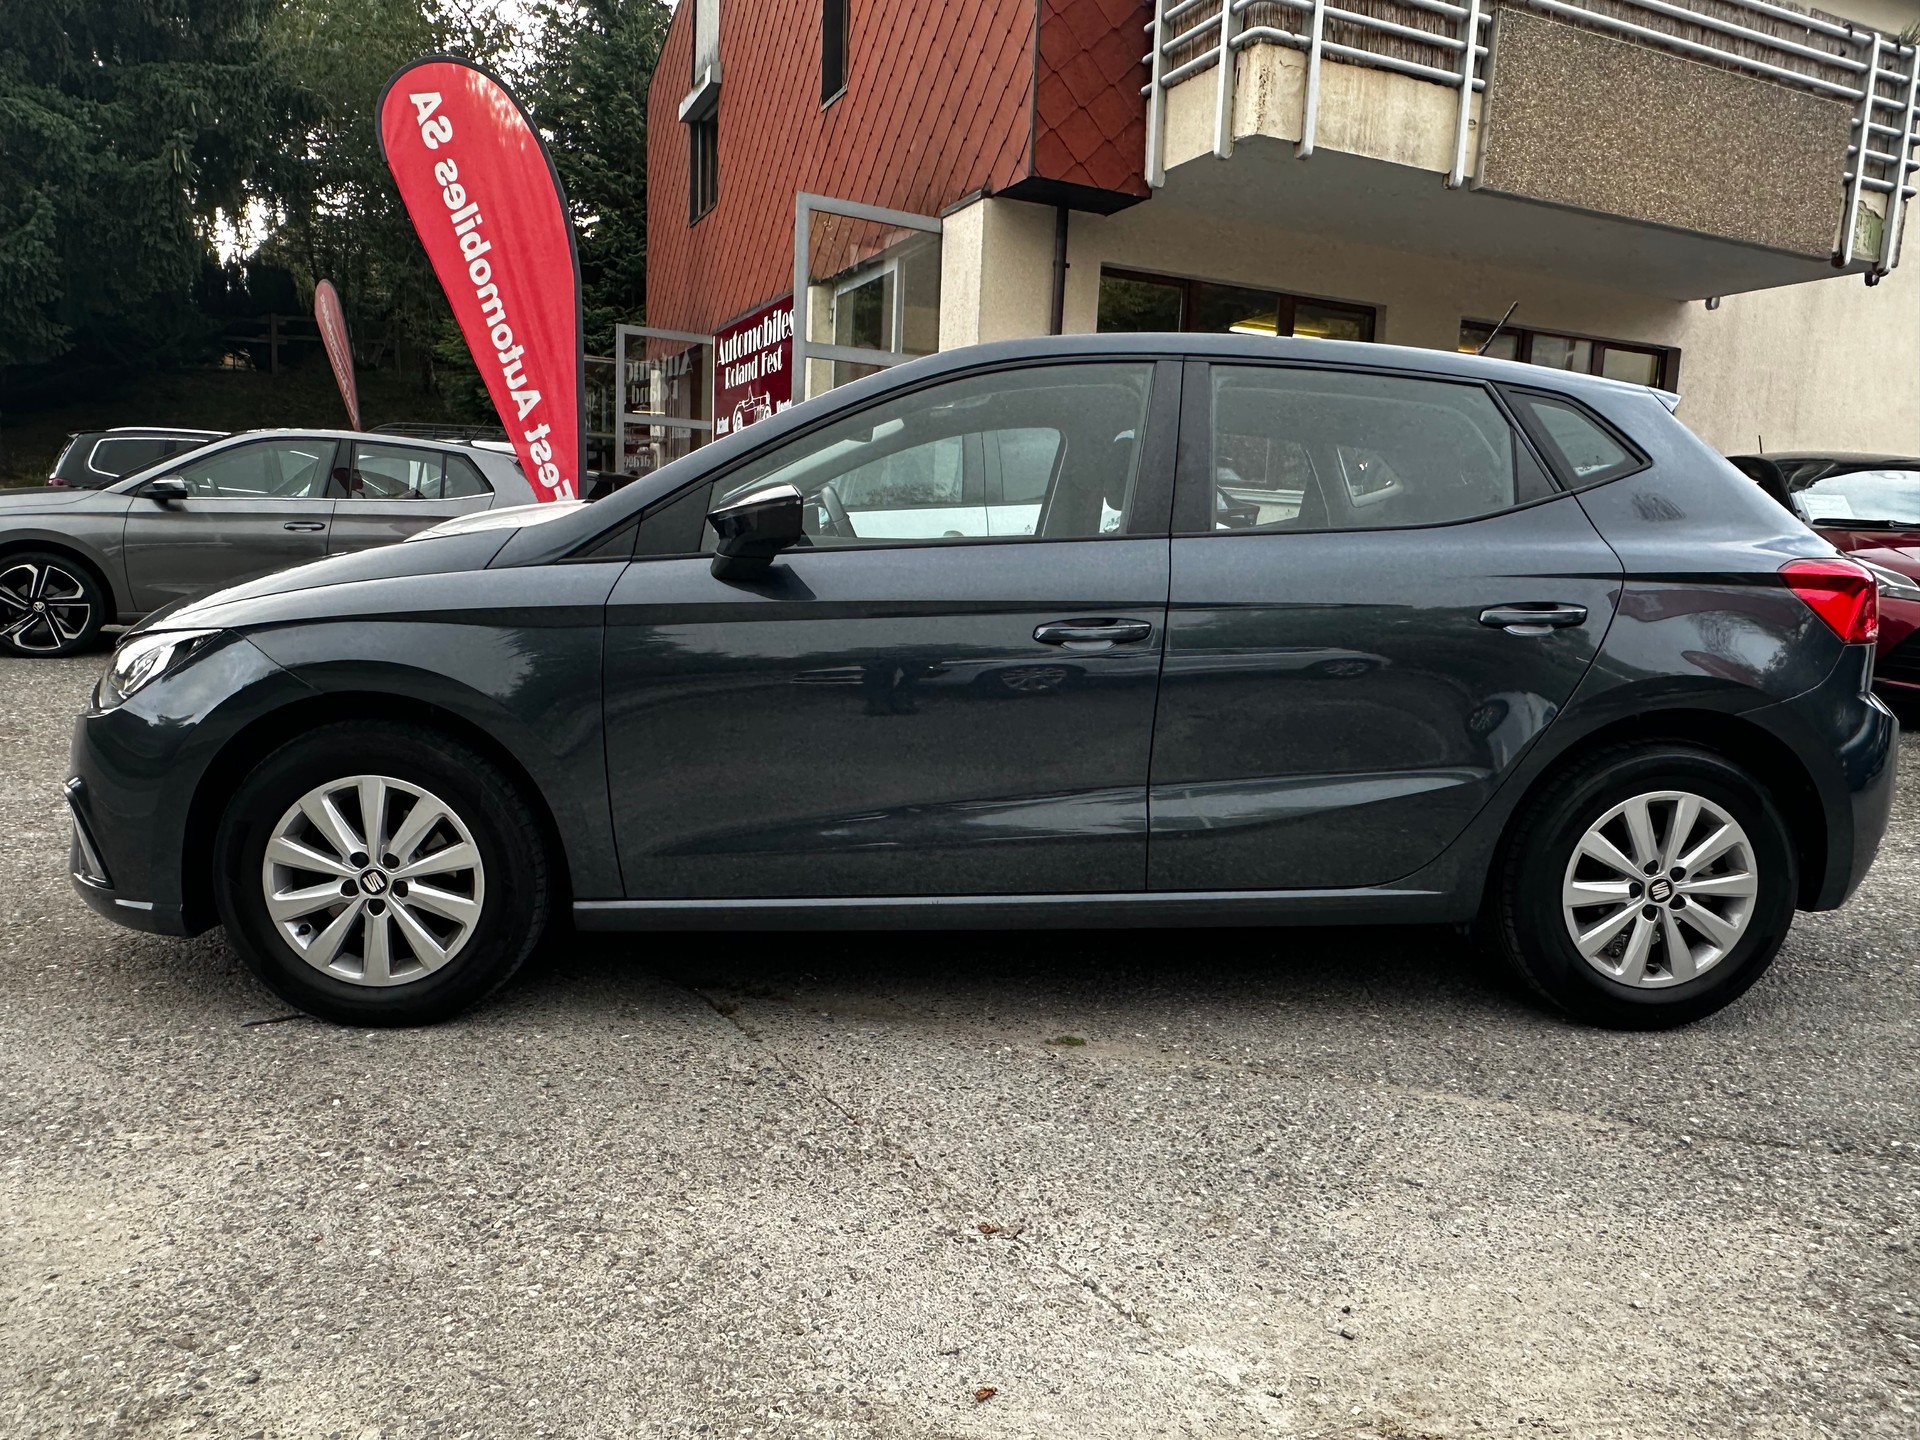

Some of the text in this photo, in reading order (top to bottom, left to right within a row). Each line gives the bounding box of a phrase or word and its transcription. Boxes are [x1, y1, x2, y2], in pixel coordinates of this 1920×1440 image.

[717, 308, 794, 367] Automobiles
[725, 357, 758, 390] Roland
[761, 345, 783, 377] Fest
